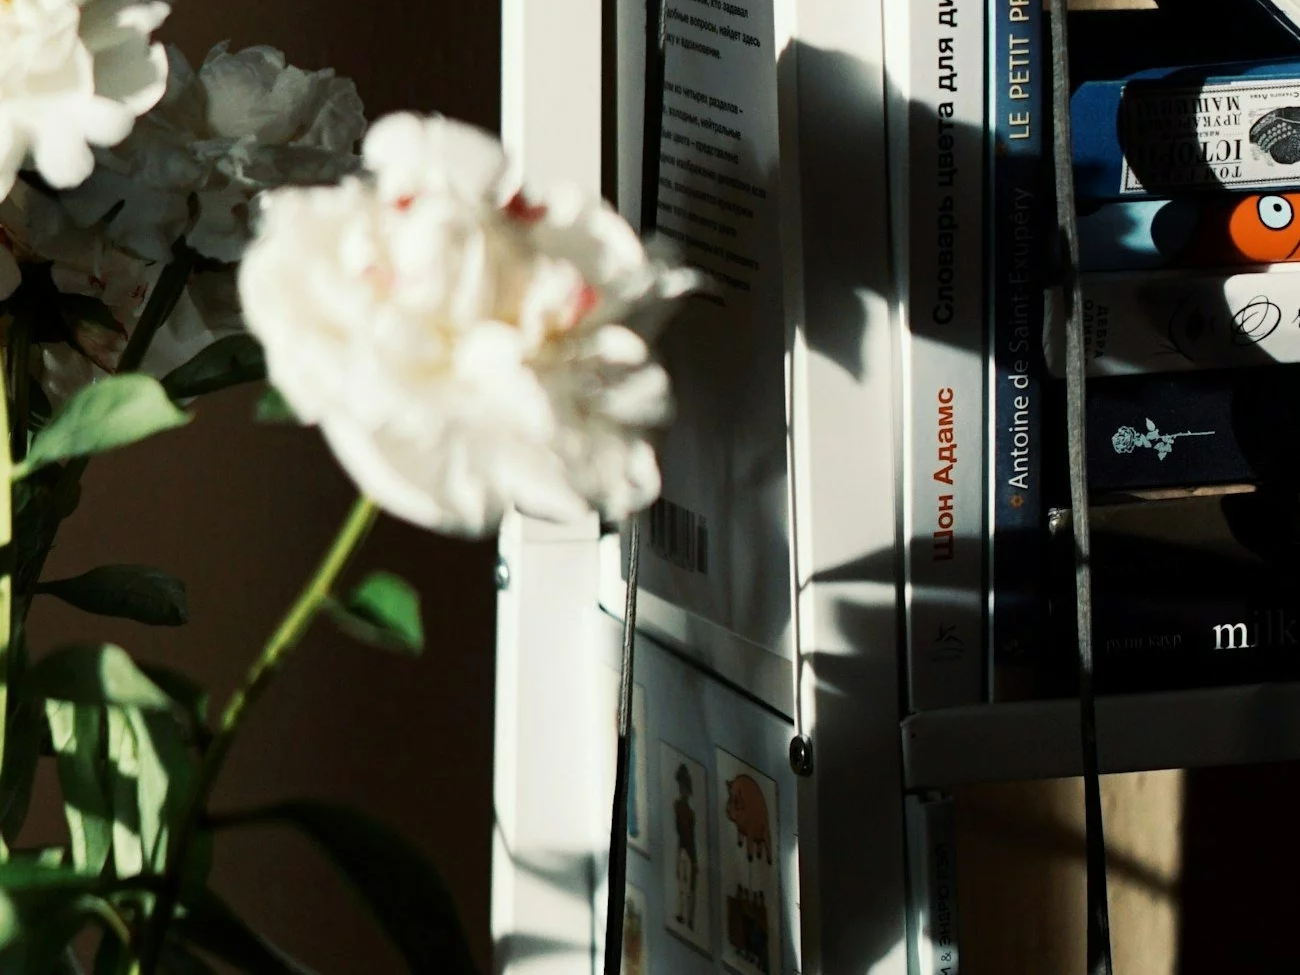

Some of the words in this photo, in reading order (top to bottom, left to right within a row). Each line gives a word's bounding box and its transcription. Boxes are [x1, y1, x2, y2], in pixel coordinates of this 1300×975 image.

[938, 36, 958, 93] для
[1009, 34, 1031, 99] PETIT
[938, 100, 958, 188] цвета
[1009, 111, 1031, 140] LE
[933, 194, 958, 325] Словарь
[1008, 357, 1029, 389] de
[933, 387, 958, 485] Адамс
[1008, 394, 1029, 490] Antoine
[932, 494, 954, 562] Шон
[1213, 605, 1299, 651] milk
